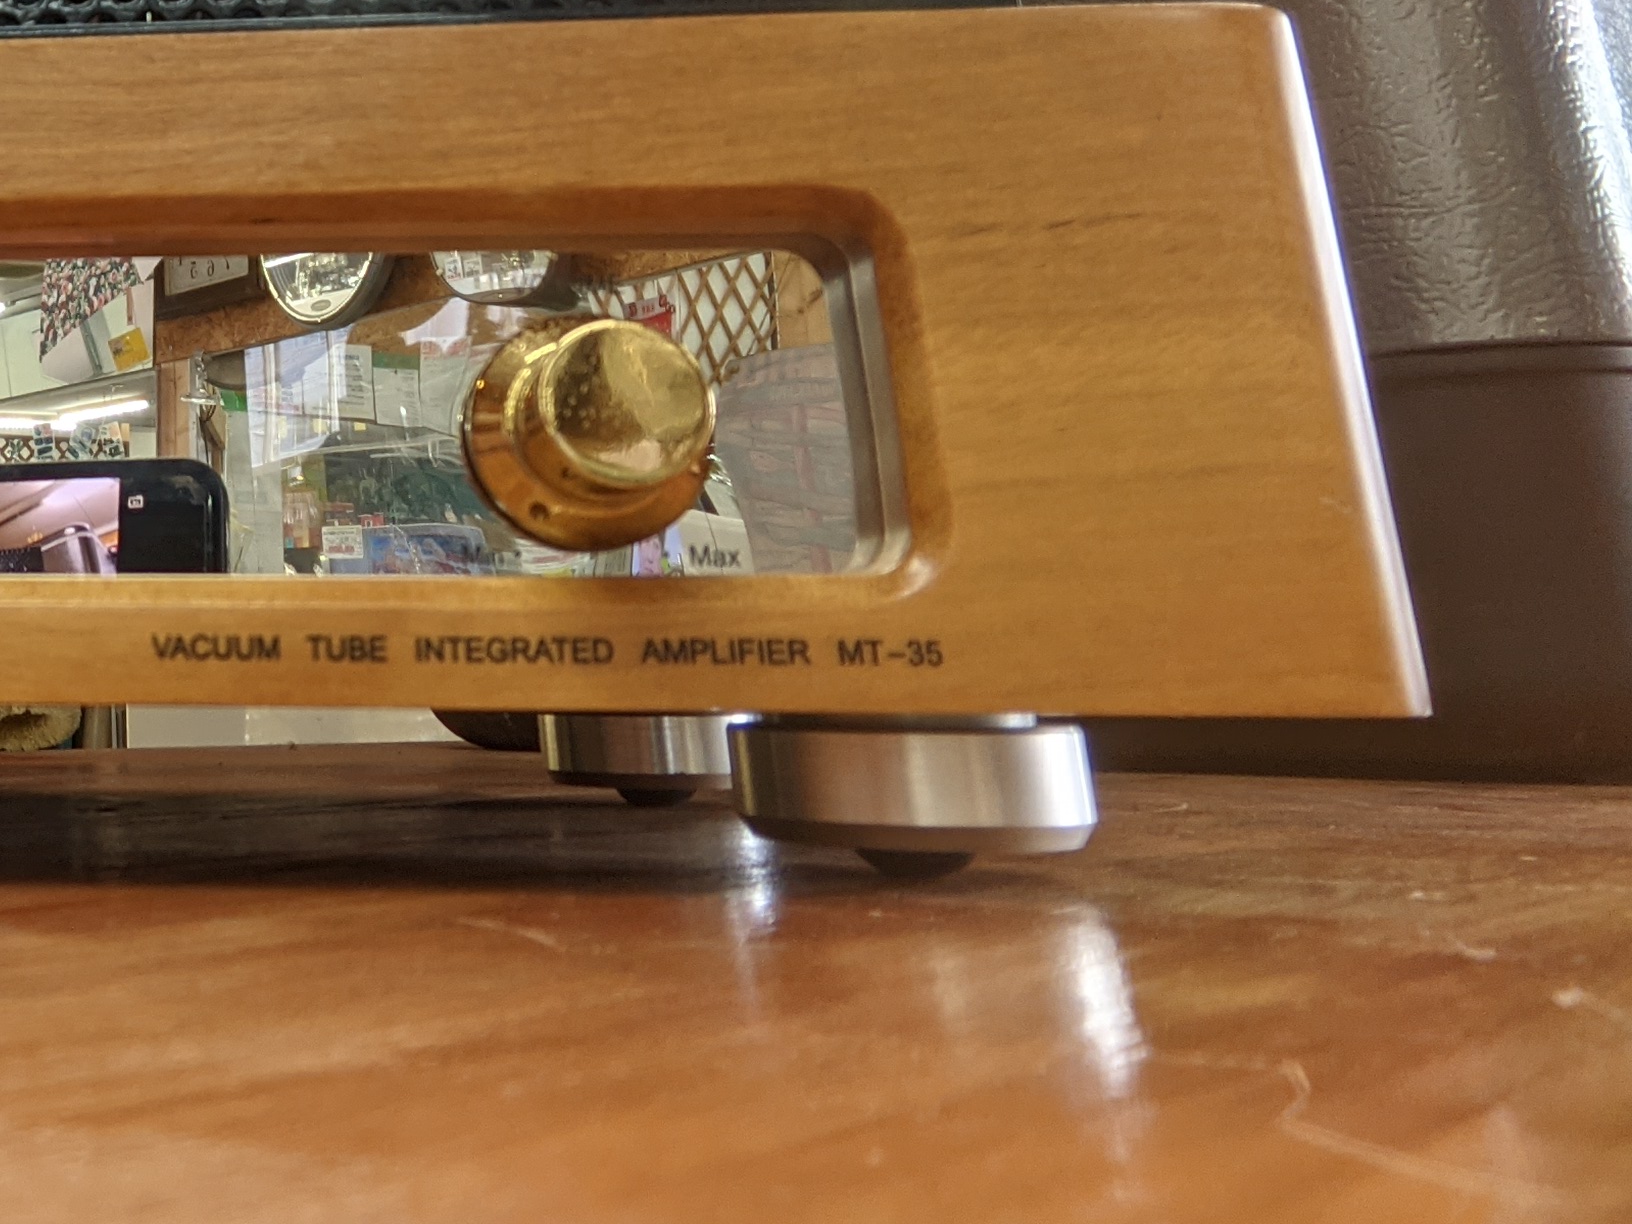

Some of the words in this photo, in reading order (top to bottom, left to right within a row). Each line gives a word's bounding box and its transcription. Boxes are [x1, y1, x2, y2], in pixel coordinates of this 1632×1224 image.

[689, 544, 741, 569] Max
[151, 634, 281, 661] VACUUM
[306, 634, 388, 663] TUBE
[414, 634, 615, 665] INTEGRATED
[642, 637, 811, 667] AMPLIFIER
[836, 639, 944, 668] MT-35
